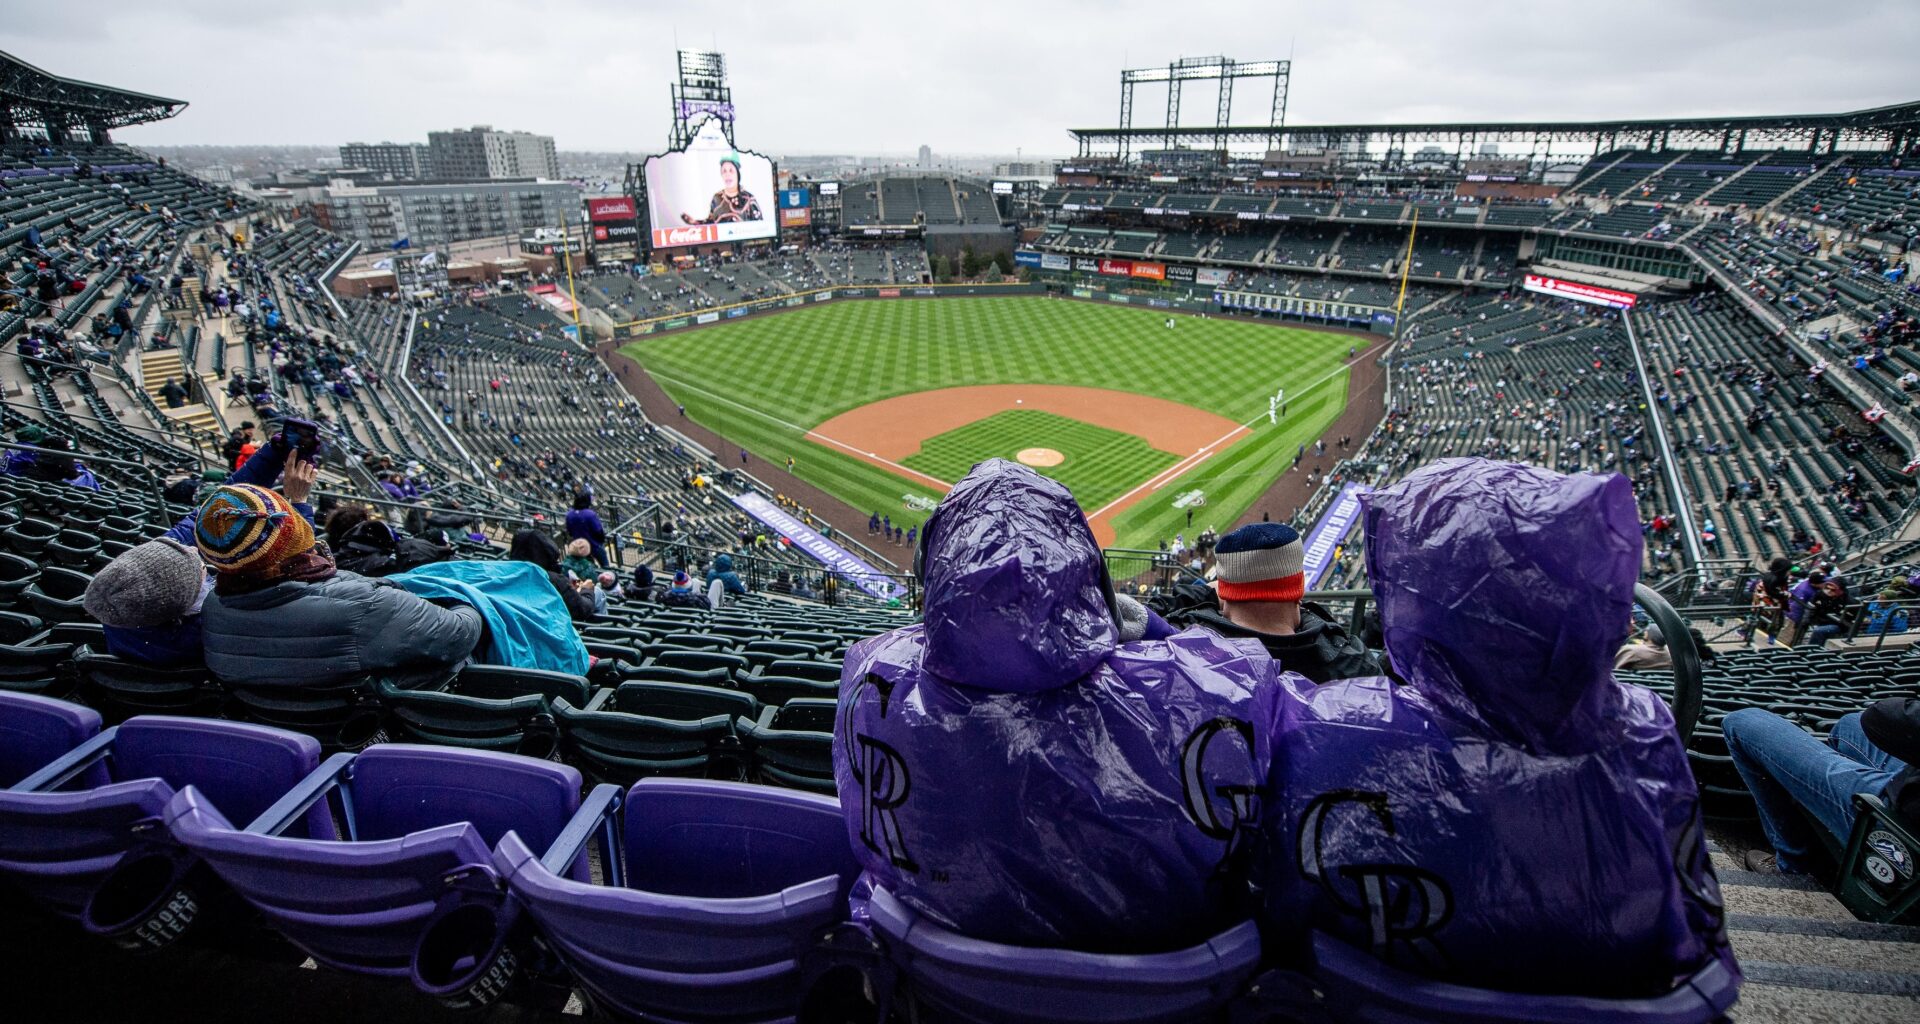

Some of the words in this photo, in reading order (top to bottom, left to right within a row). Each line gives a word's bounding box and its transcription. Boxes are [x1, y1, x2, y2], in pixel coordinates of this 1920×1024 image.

[608, 227, 637, 236] TOYOTA
[1135, 266, 1161, 275] STIHL
[762, 509, 800, 535] WELCOME
[796, 532, 813, 544] TO
[809, 540, 843, 561] COORS
[930, 870, 950, 883] TM
[1871, 861, 1889, 878] 19
[136, 891, 188, 938] COORS
[147, 900, 199, 946] FIELD
[470, 946, 511, 998] COORS
[476, 954, 517, 1005] FIELD
